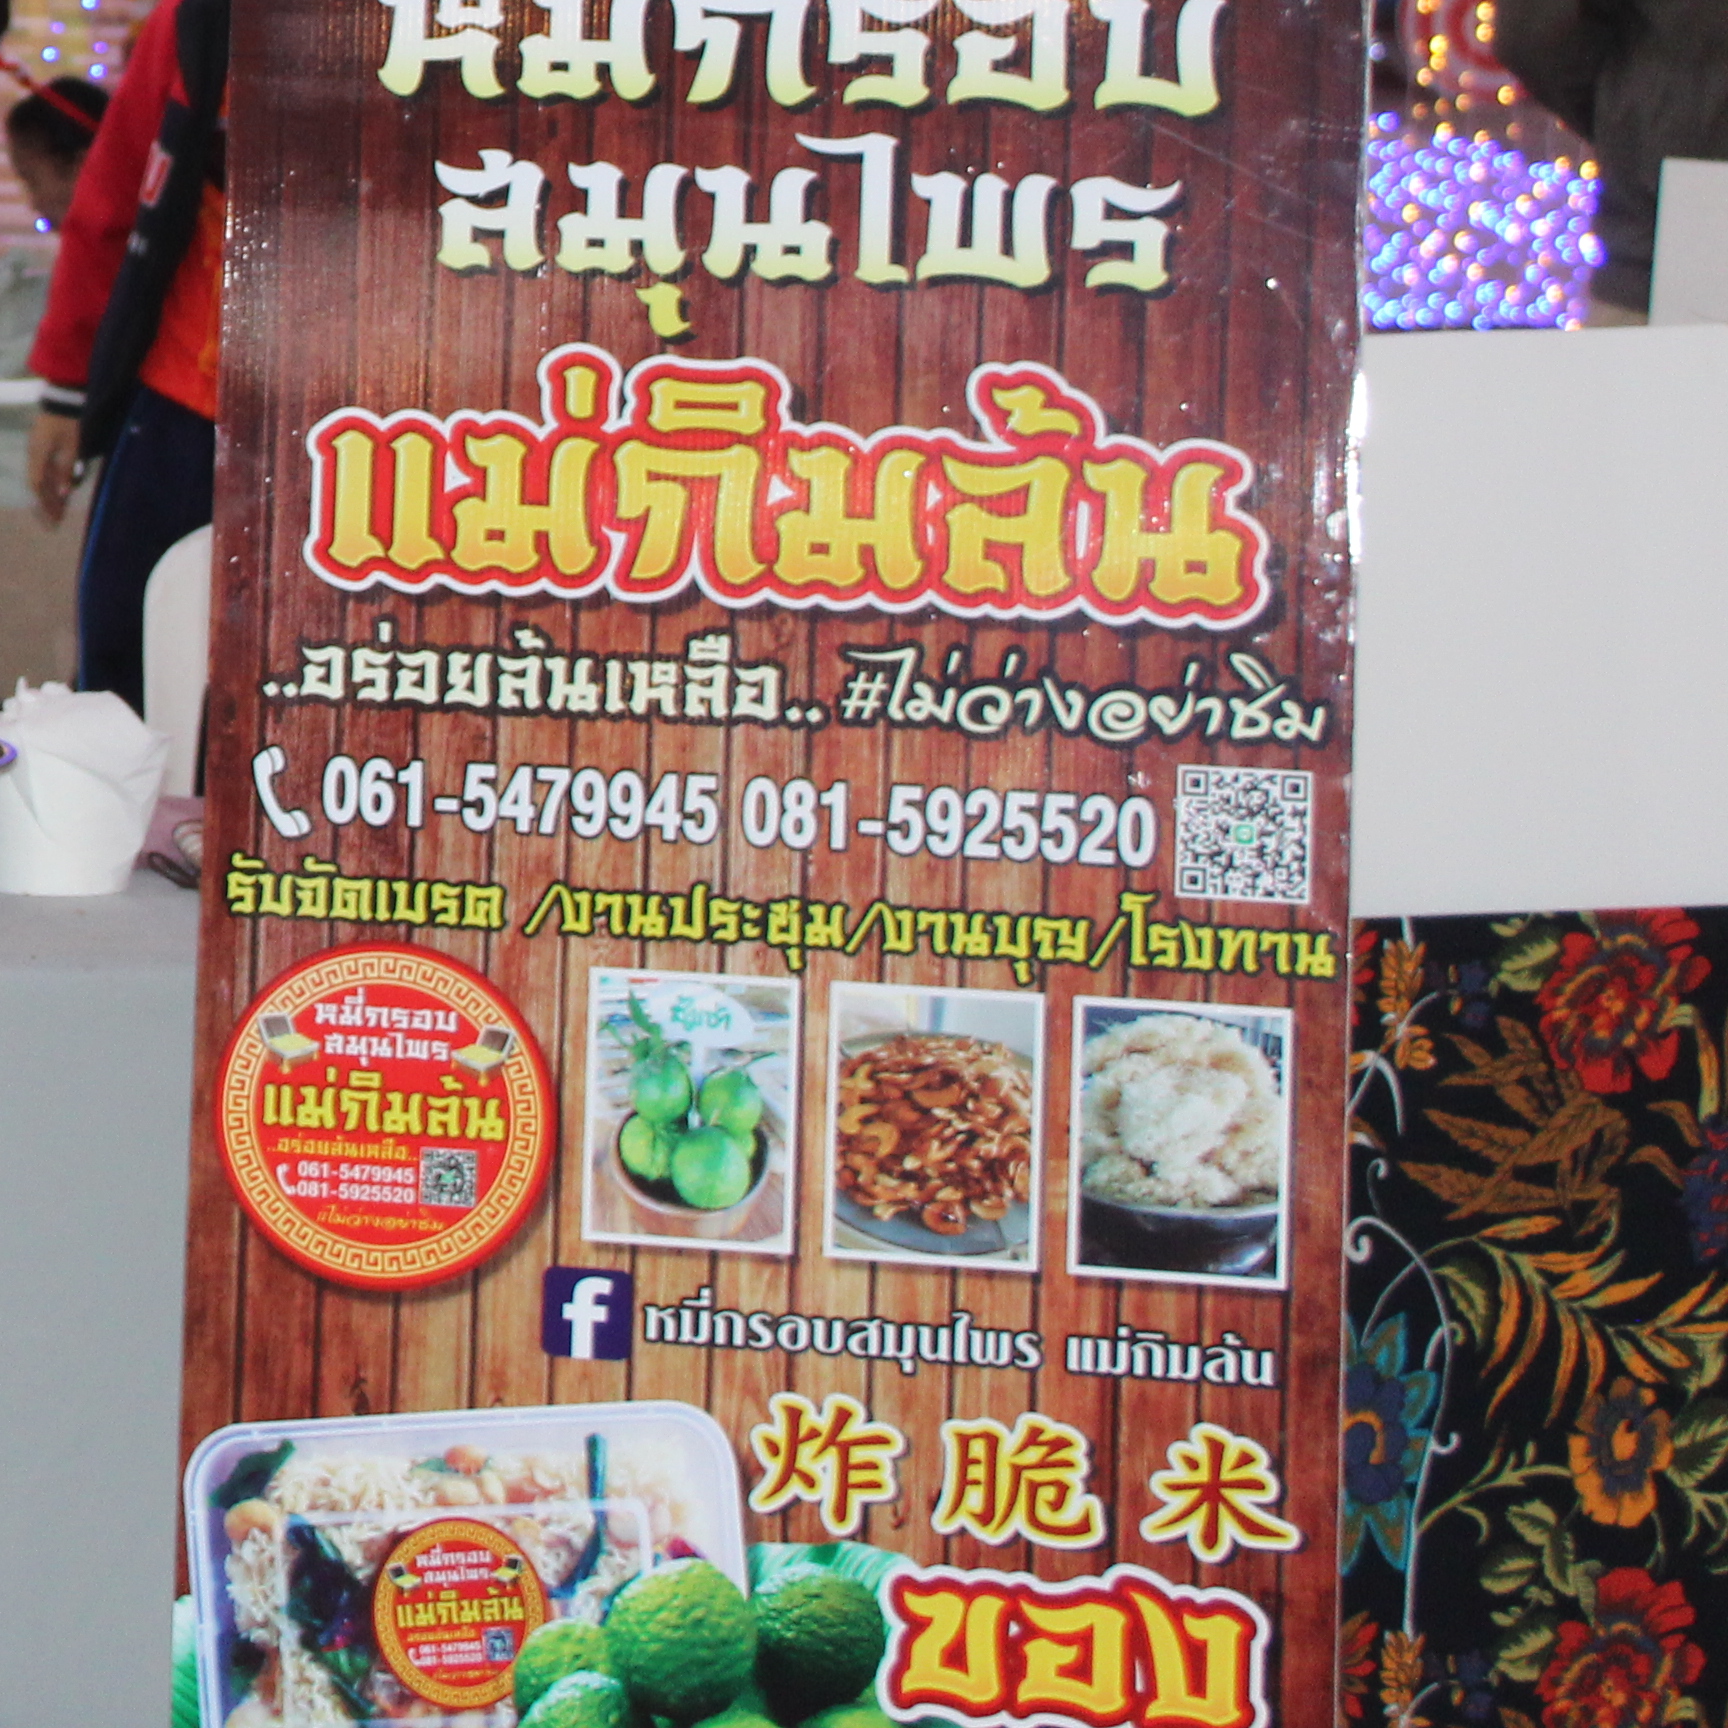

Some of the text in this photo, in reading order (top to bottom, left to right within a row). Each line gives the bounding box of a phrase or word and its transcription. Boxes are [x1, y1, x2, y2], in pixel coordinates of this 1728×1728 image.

[432, 131, 1184, 341] สมุนไพร
[321, 359, 1250, 611] แม่กิมล้น
[321, 755, 1157, 867] 061-5479945 081-5925520
[314, 987, 459, 1033] หมี่กรอบ
[324, 1032, 451, 1067] สมุนไพร
[296, 1179, 416, 1204] 081-5925520
[297, 1160, 416, 1184] 061-5479945
[643, 1286, 1042, 1374] หมี่กรอบสมุนไพร
[1065, 1324, 1277, 1386] แม่กิมล้น
[894, 1582, 1249, 1727] ของ
